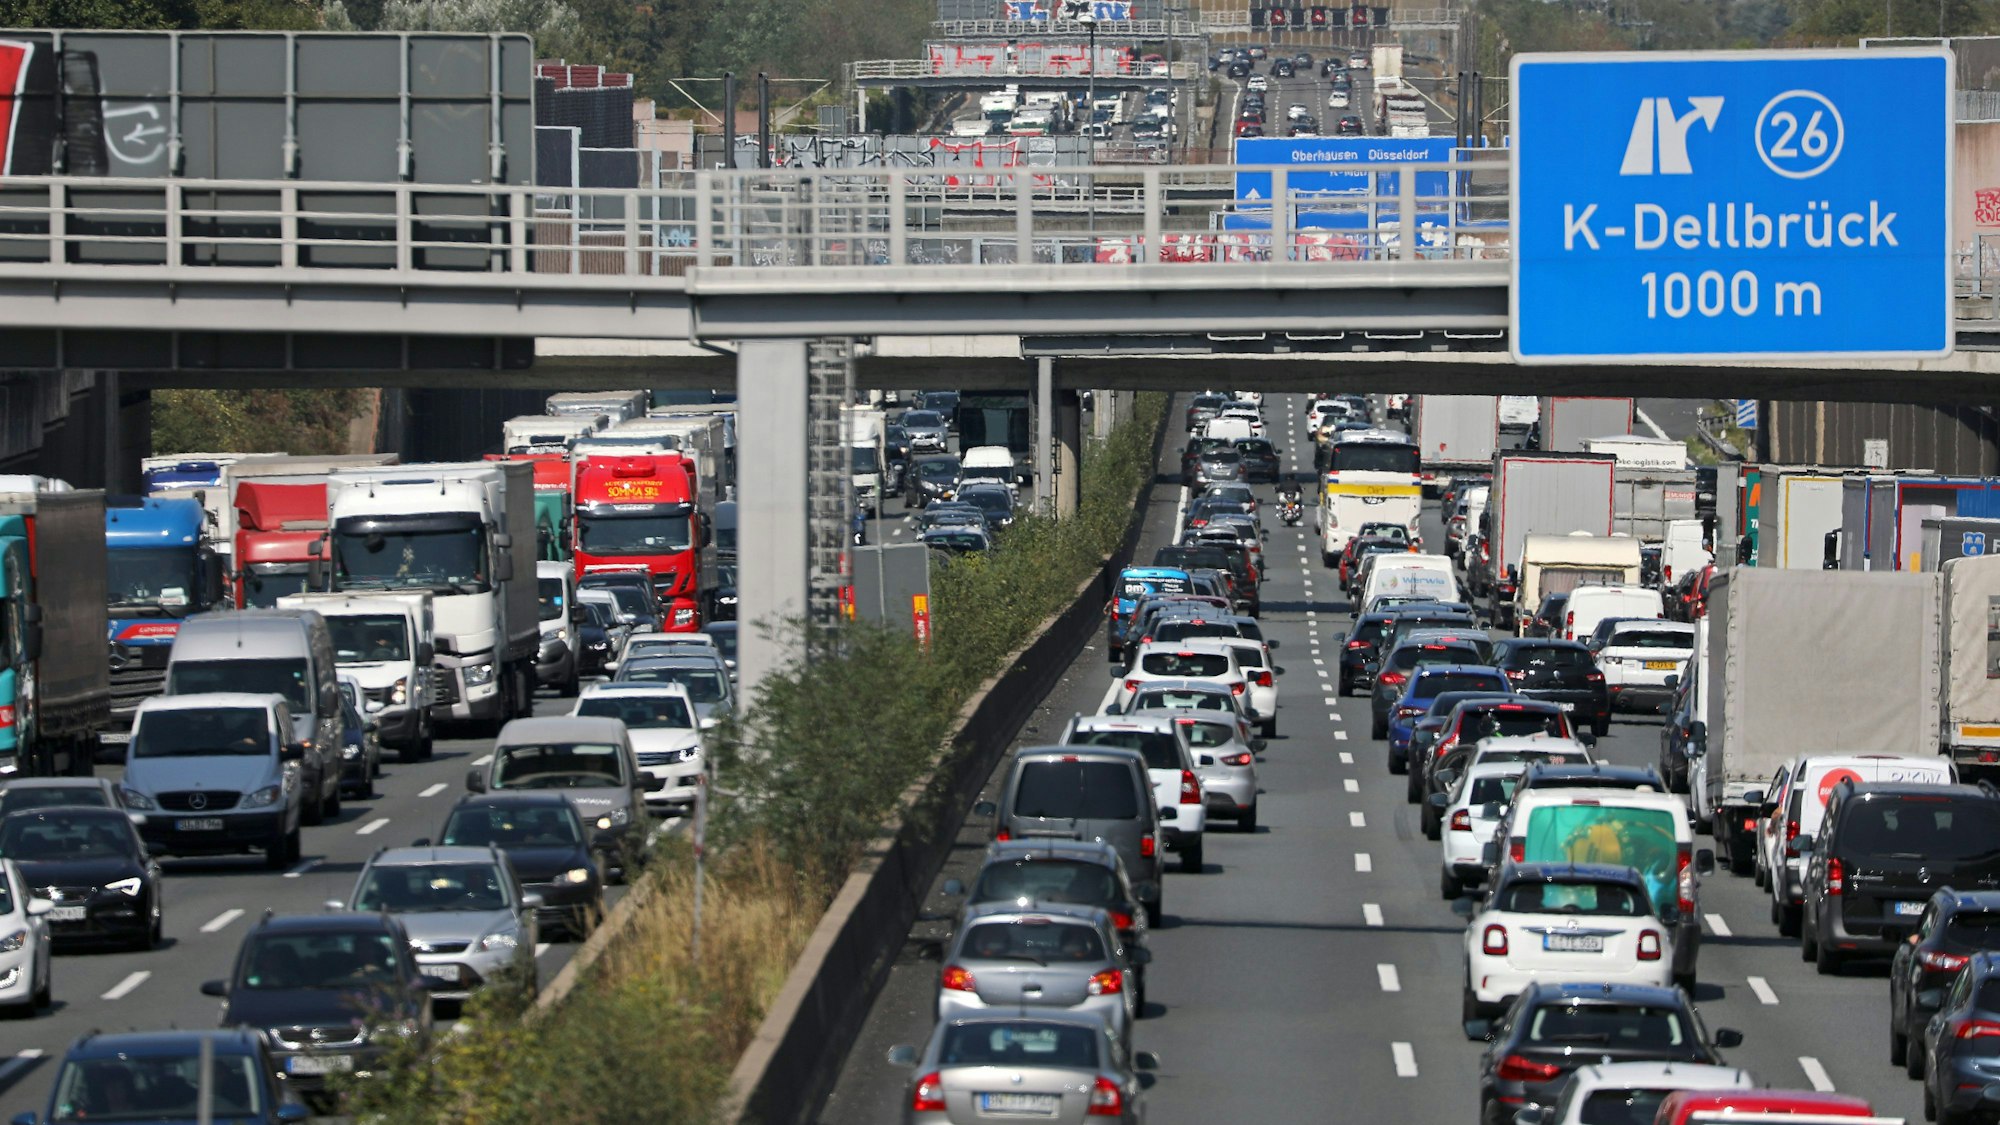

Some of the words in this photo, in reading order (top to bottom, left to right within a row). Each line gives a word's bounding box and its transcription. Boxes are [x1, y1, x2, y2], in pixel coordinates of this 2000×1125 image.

[1769, 110, 1829, 158] 26
[1291, 150, 1358, 162] Oberhausen
[1367, 149, 1429, 161] Düsseldorf
[1563, 200, 1899, 251] K-Dellbrück
[1641, 269, 1758, 319] 1000
[1774, 281, 1822, 316] m
[608, 486, 642, 497] SOMMA
[1125, 584, 1143, 595] pm
